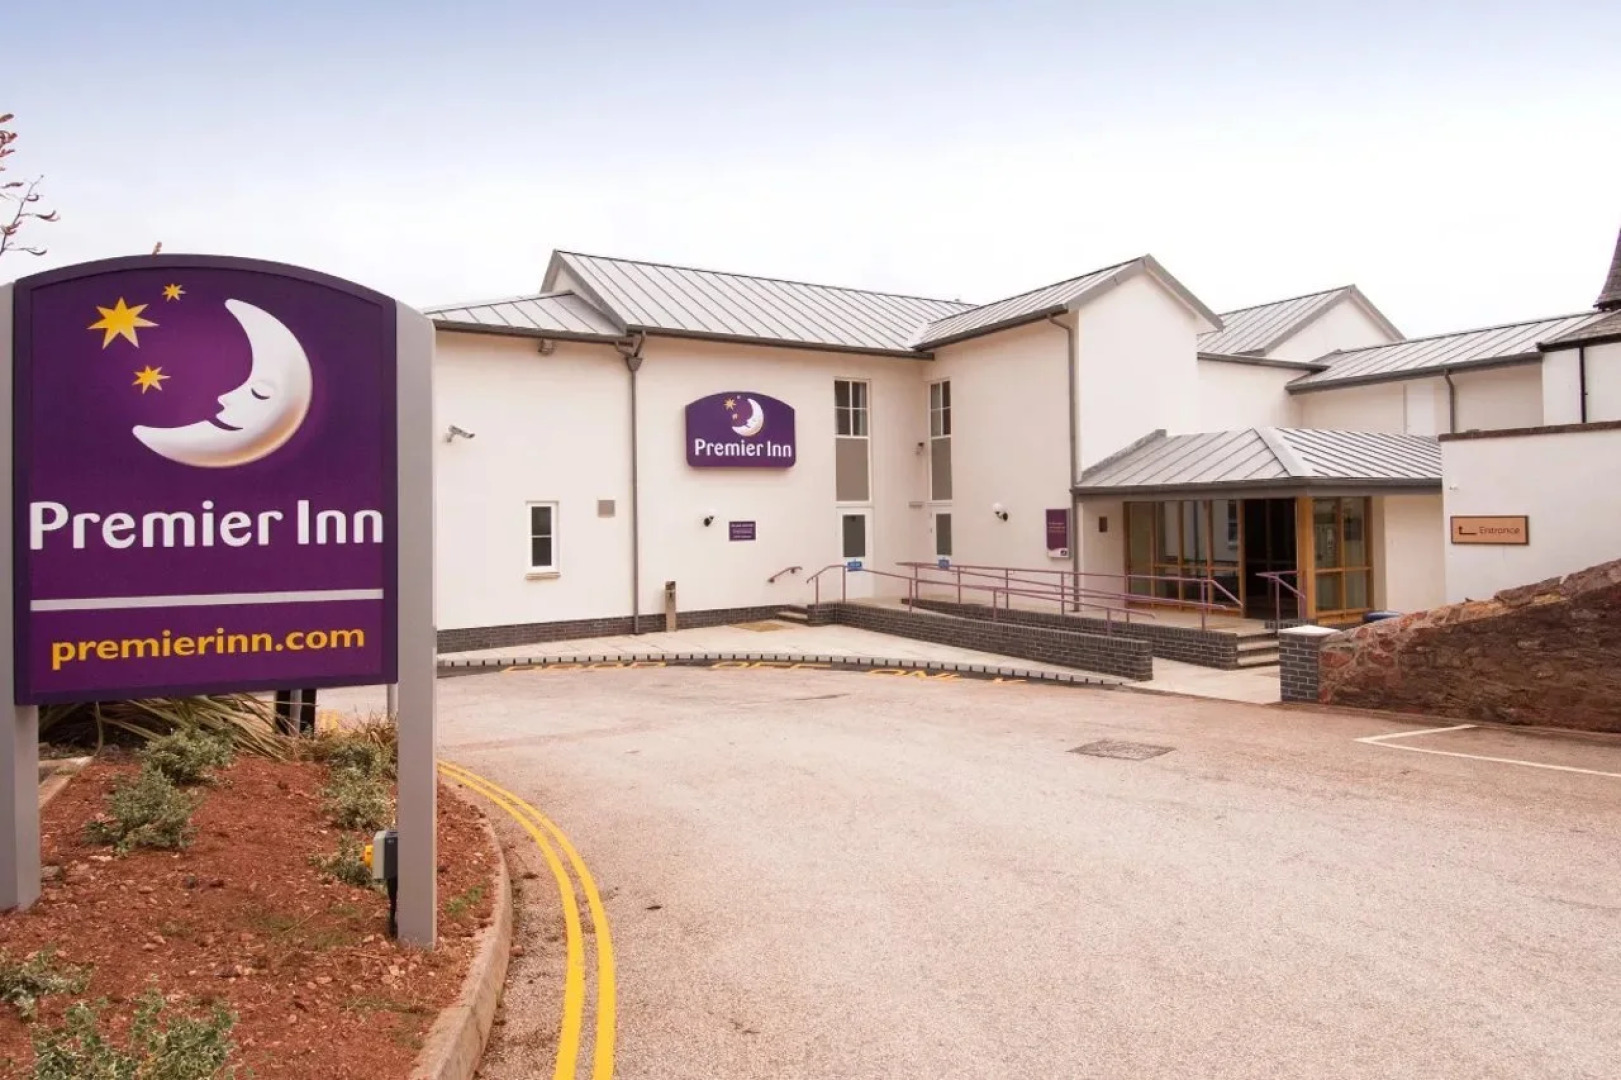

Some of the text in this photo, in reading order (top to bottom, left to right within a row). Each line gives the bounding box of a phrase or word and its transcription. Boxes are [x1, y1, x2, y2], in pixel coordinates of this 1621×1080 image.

[694, 438, 792, 457] Premier Inn
[29, 499, 384, 551] Premier Inn
[1479, 526, 1520, 534] Entrance
[51, 627, 366, 671] premierinn.com
